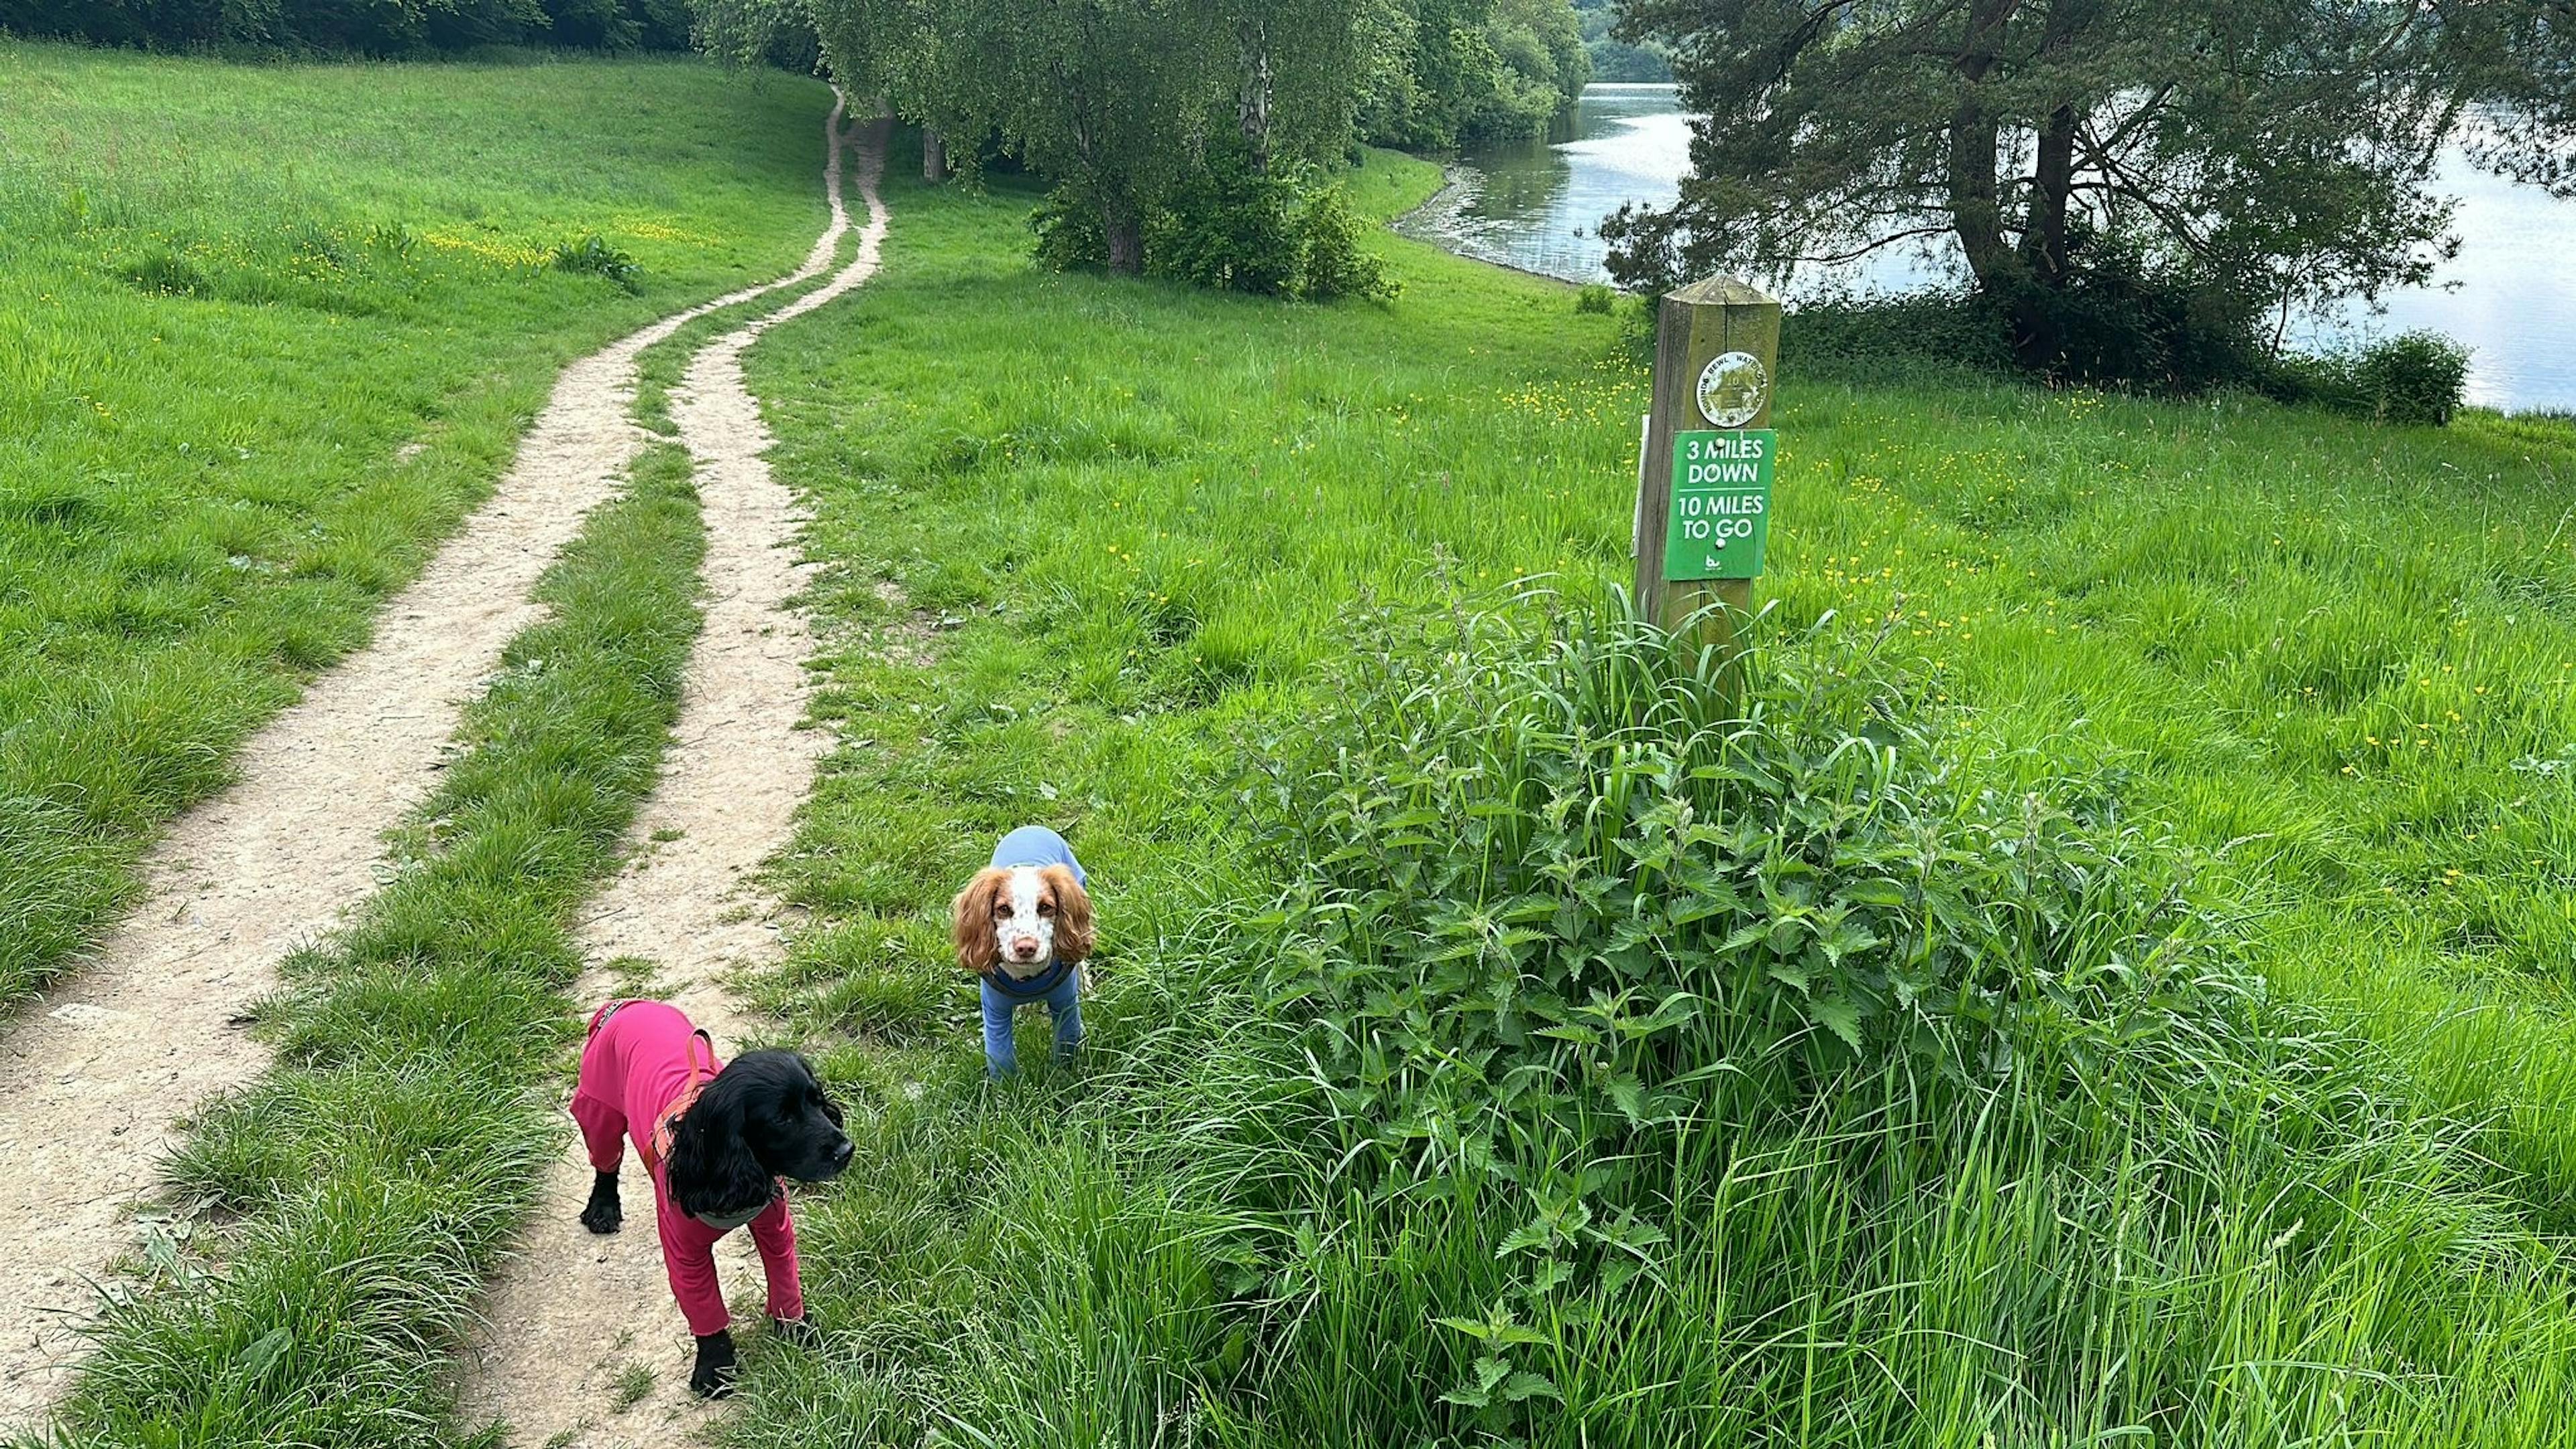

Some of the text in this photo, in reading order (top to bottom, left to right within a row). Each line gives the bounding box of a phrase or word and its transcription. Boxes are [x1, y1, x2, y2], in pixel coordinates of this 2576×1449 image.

[1708, 357, 1729, 374] BEWL
[1686, 439, 1764, 460] 3 MILES
[1688, 462, 1758, 484] DOWN
[1678, 495, 1764, 516] 10 MILES
[1682, 518, 1754, 539] TO GO
